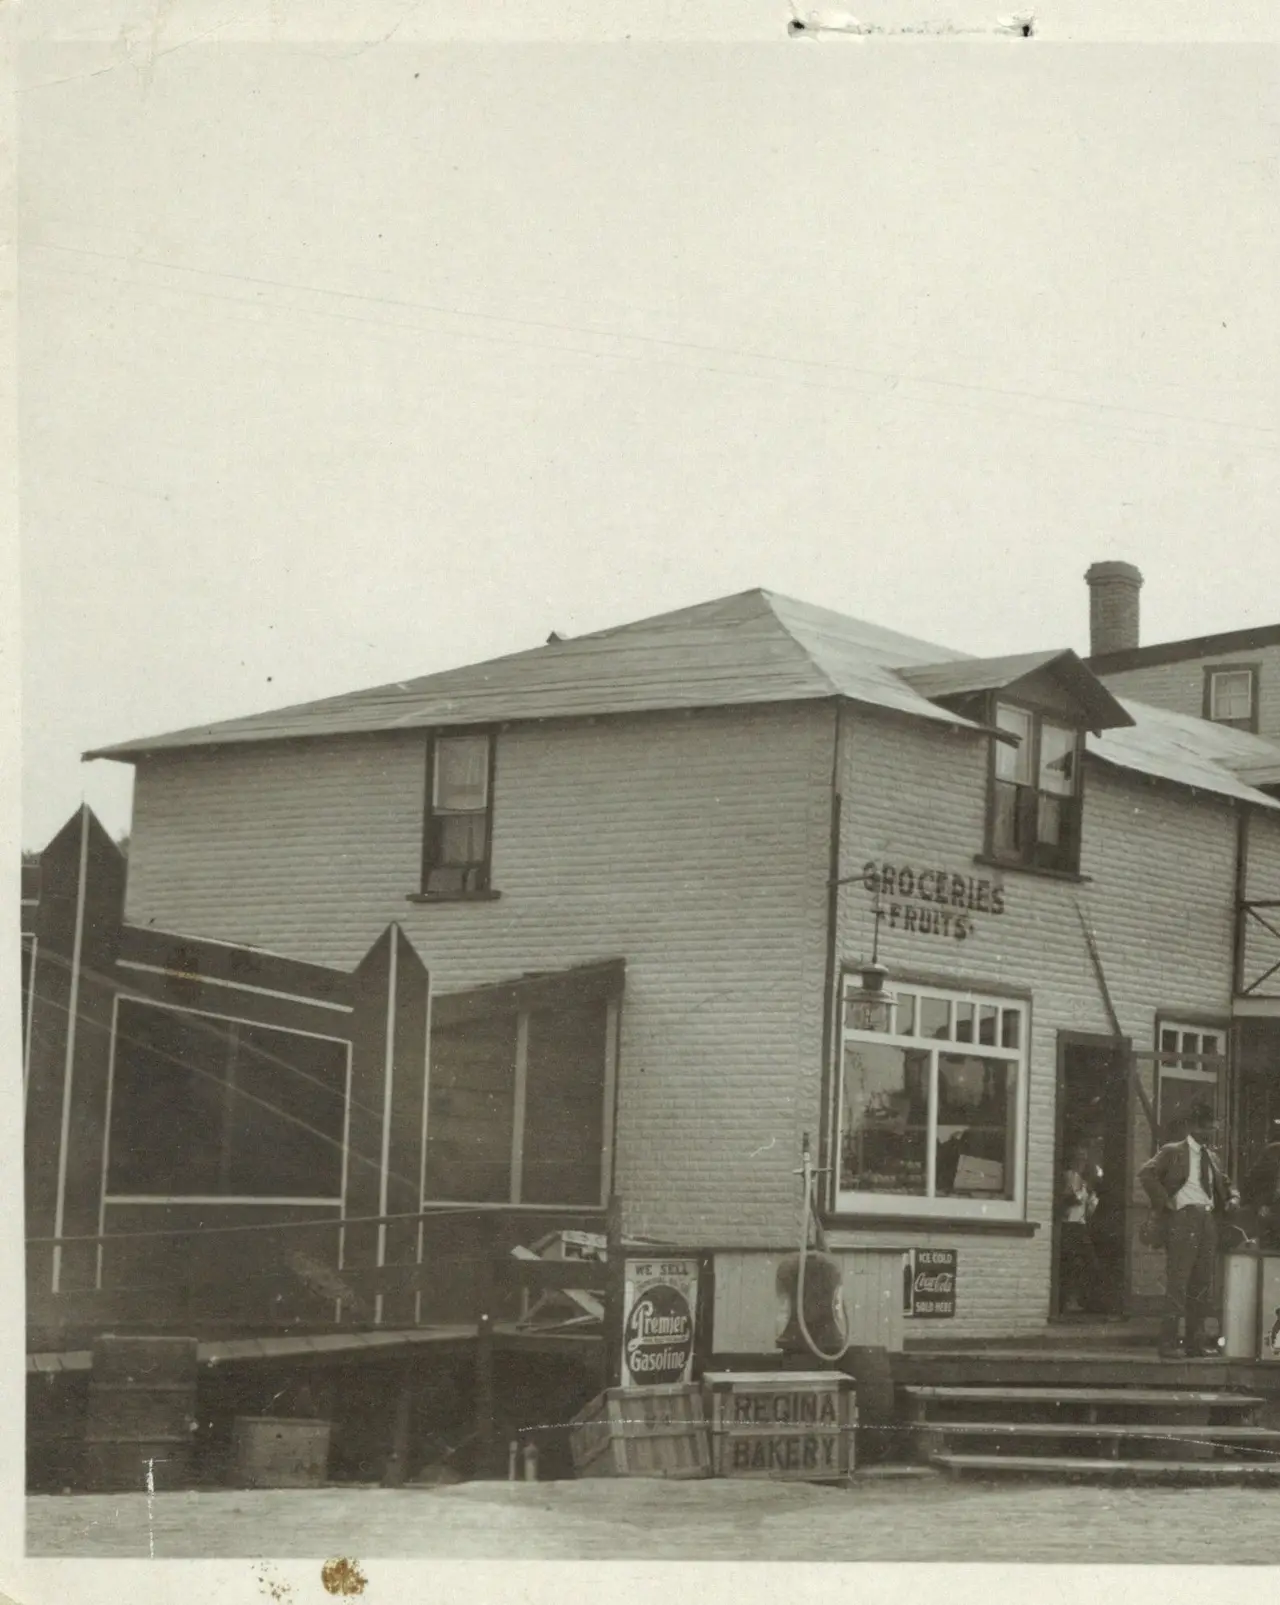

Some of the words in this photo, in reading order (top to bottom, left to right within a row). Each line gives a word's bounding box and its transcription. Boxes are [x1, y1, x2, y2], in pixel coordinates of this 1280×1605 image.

[863, 861, 1005, 915] GROCERIES
[635, 1264, 653, 1276] WE
[659, 1264, 689, 1276] SELL
[918, 1252, 931, 1264] ICE
[932, 1251, 952, 1264] COLD
[628, 1300, 690, 1351] Premier
[629, 1347, 686, 1372] Gasoline
[735, 1394, 837, 1421] REGINA
[733, 1436, 835, 1470] BAKERY
